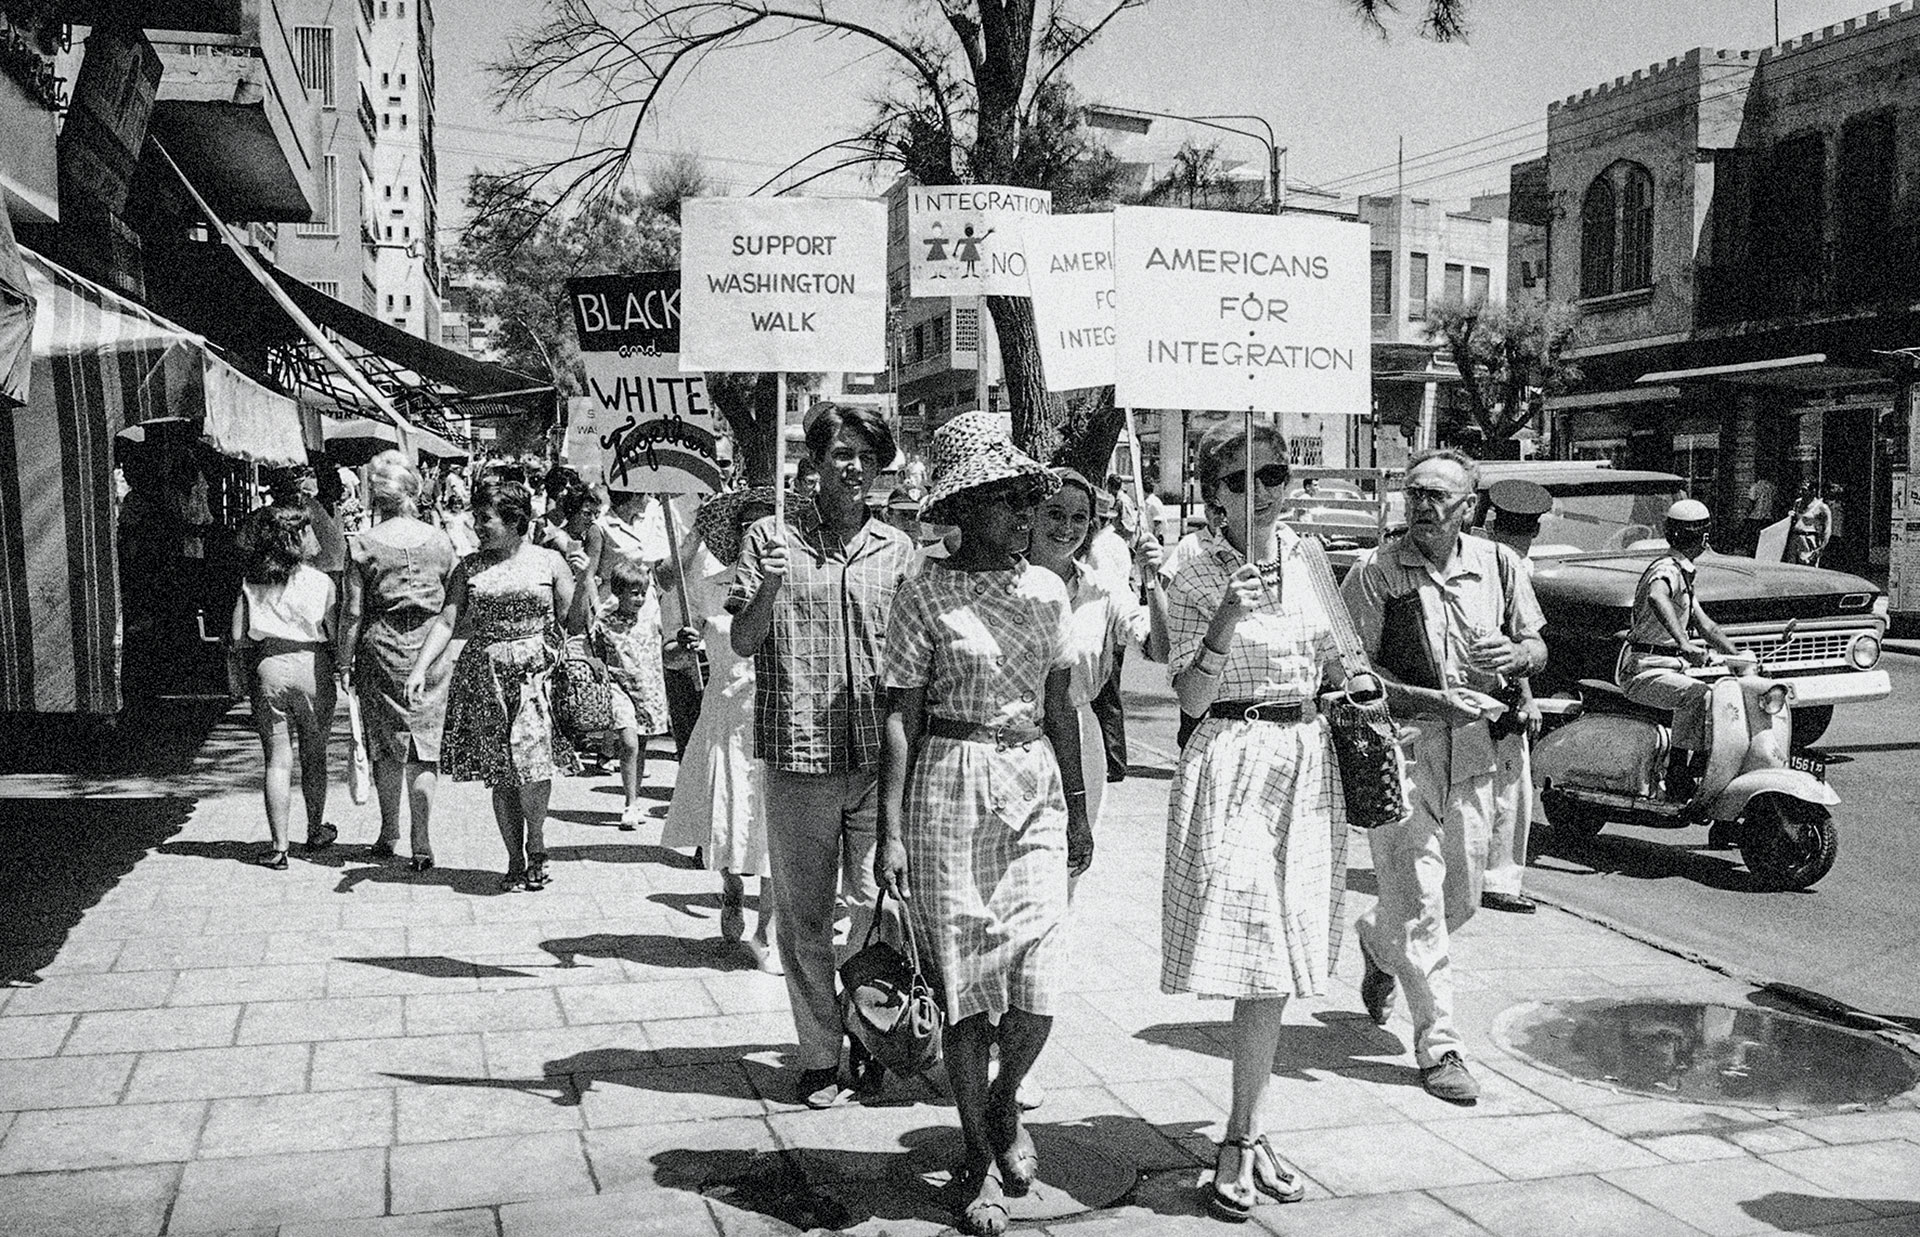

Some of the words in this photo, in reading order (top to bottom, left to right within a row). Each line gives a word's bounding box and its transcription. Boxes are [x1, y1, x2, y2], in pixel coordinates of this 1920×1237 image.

[913, 191, 1051, 215] INTEGRATION
[731, 235, 837, 256] SUPPORT
[991, 251, 1026, 277] NO
[1050, 251, 1113, 273] AMERI
[1145, 246, 1330, 280] AMERICANS
[707, 272, 856, 295] WASHINGTON
[577, 289, 681, 333] BLACK
[751, 311, 817, 332] WALK
[1218, 295, 1289, 324] FOR
[618, 339, 662, 359] and
[1060, 325, 1116, 350] INTEG
[1146, 338, 1355, 371] INTEGRATION
[590, 376, 709, 416] WHITE
